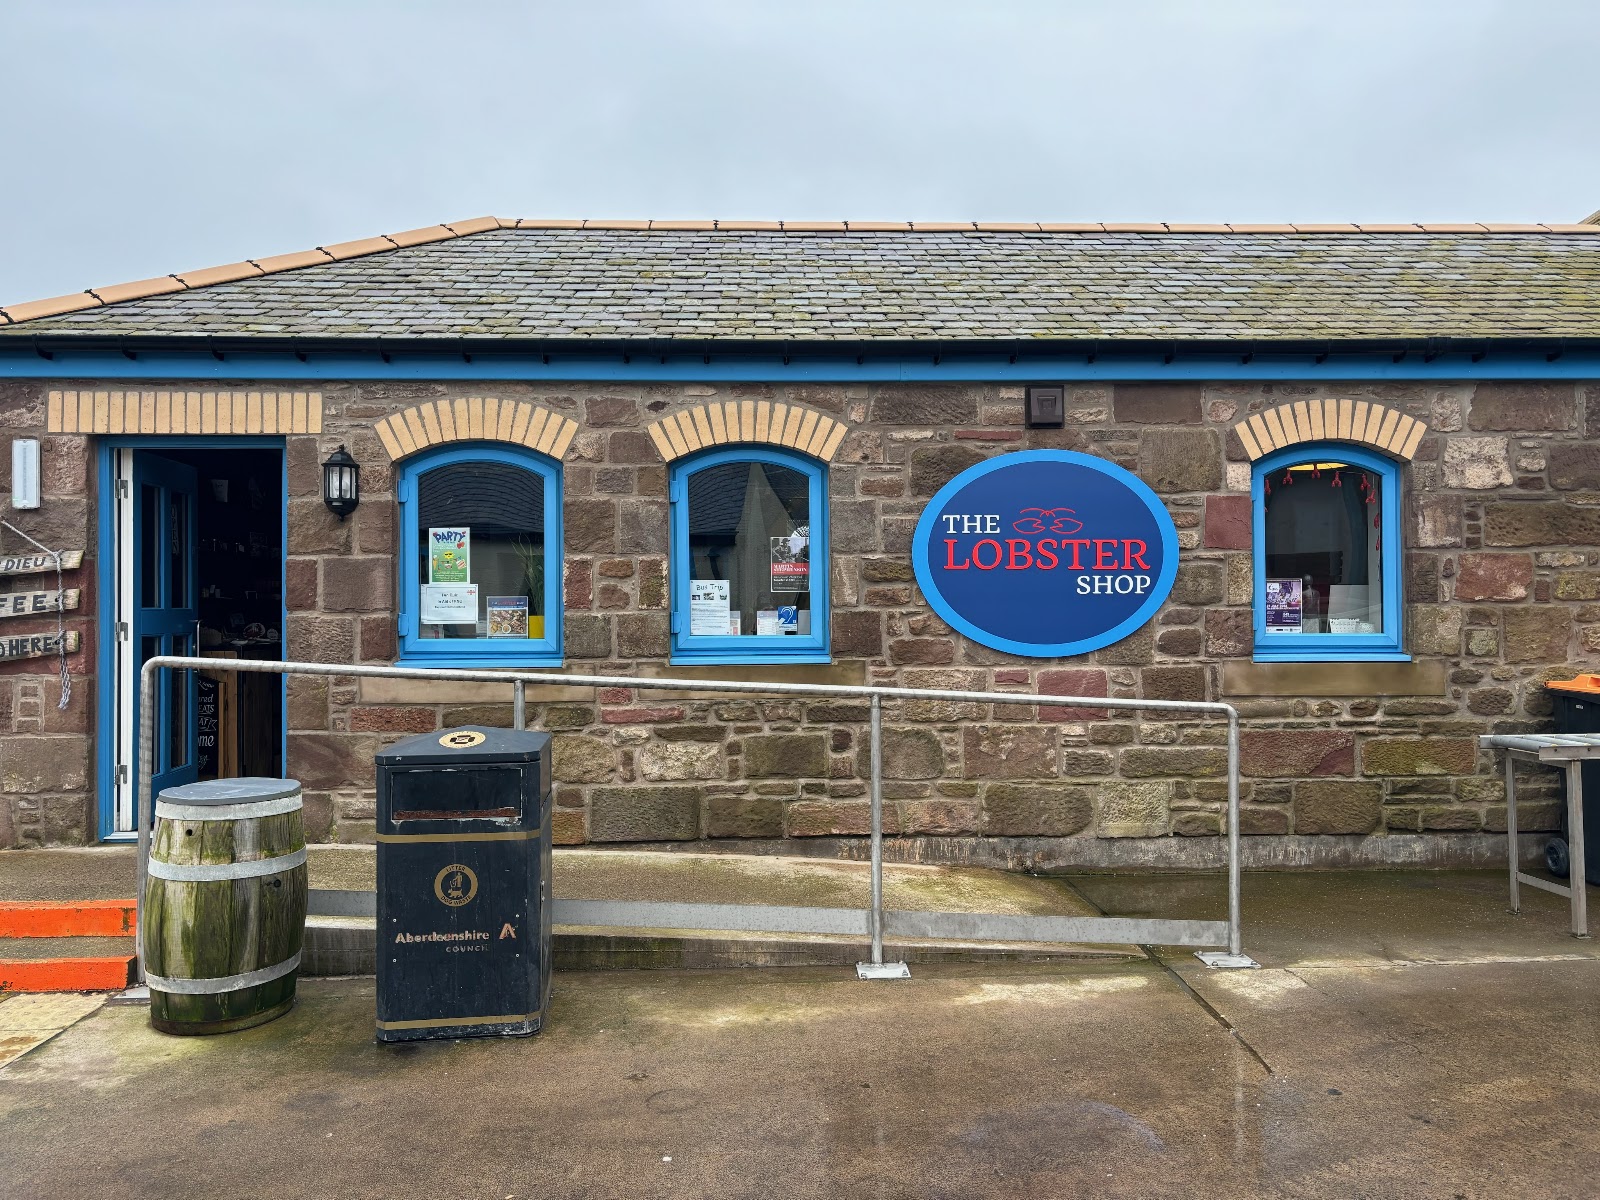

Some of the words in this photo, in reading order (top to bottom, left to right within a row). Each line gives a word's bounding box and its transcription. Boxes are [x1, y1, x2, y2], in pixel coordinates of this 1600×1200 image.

[942, 514, 1001, 534] THE
[433, 531, 465, 543] PARTY
[943, 538, 1151, 570] LOBSTER
[1076, 575, 1151, 594] SHOP
[446, 865, 466, 873] LITTER
[395, 930, 490, 944] Aberdeenshire
[445, 944, 489, 953] COUNCIL
